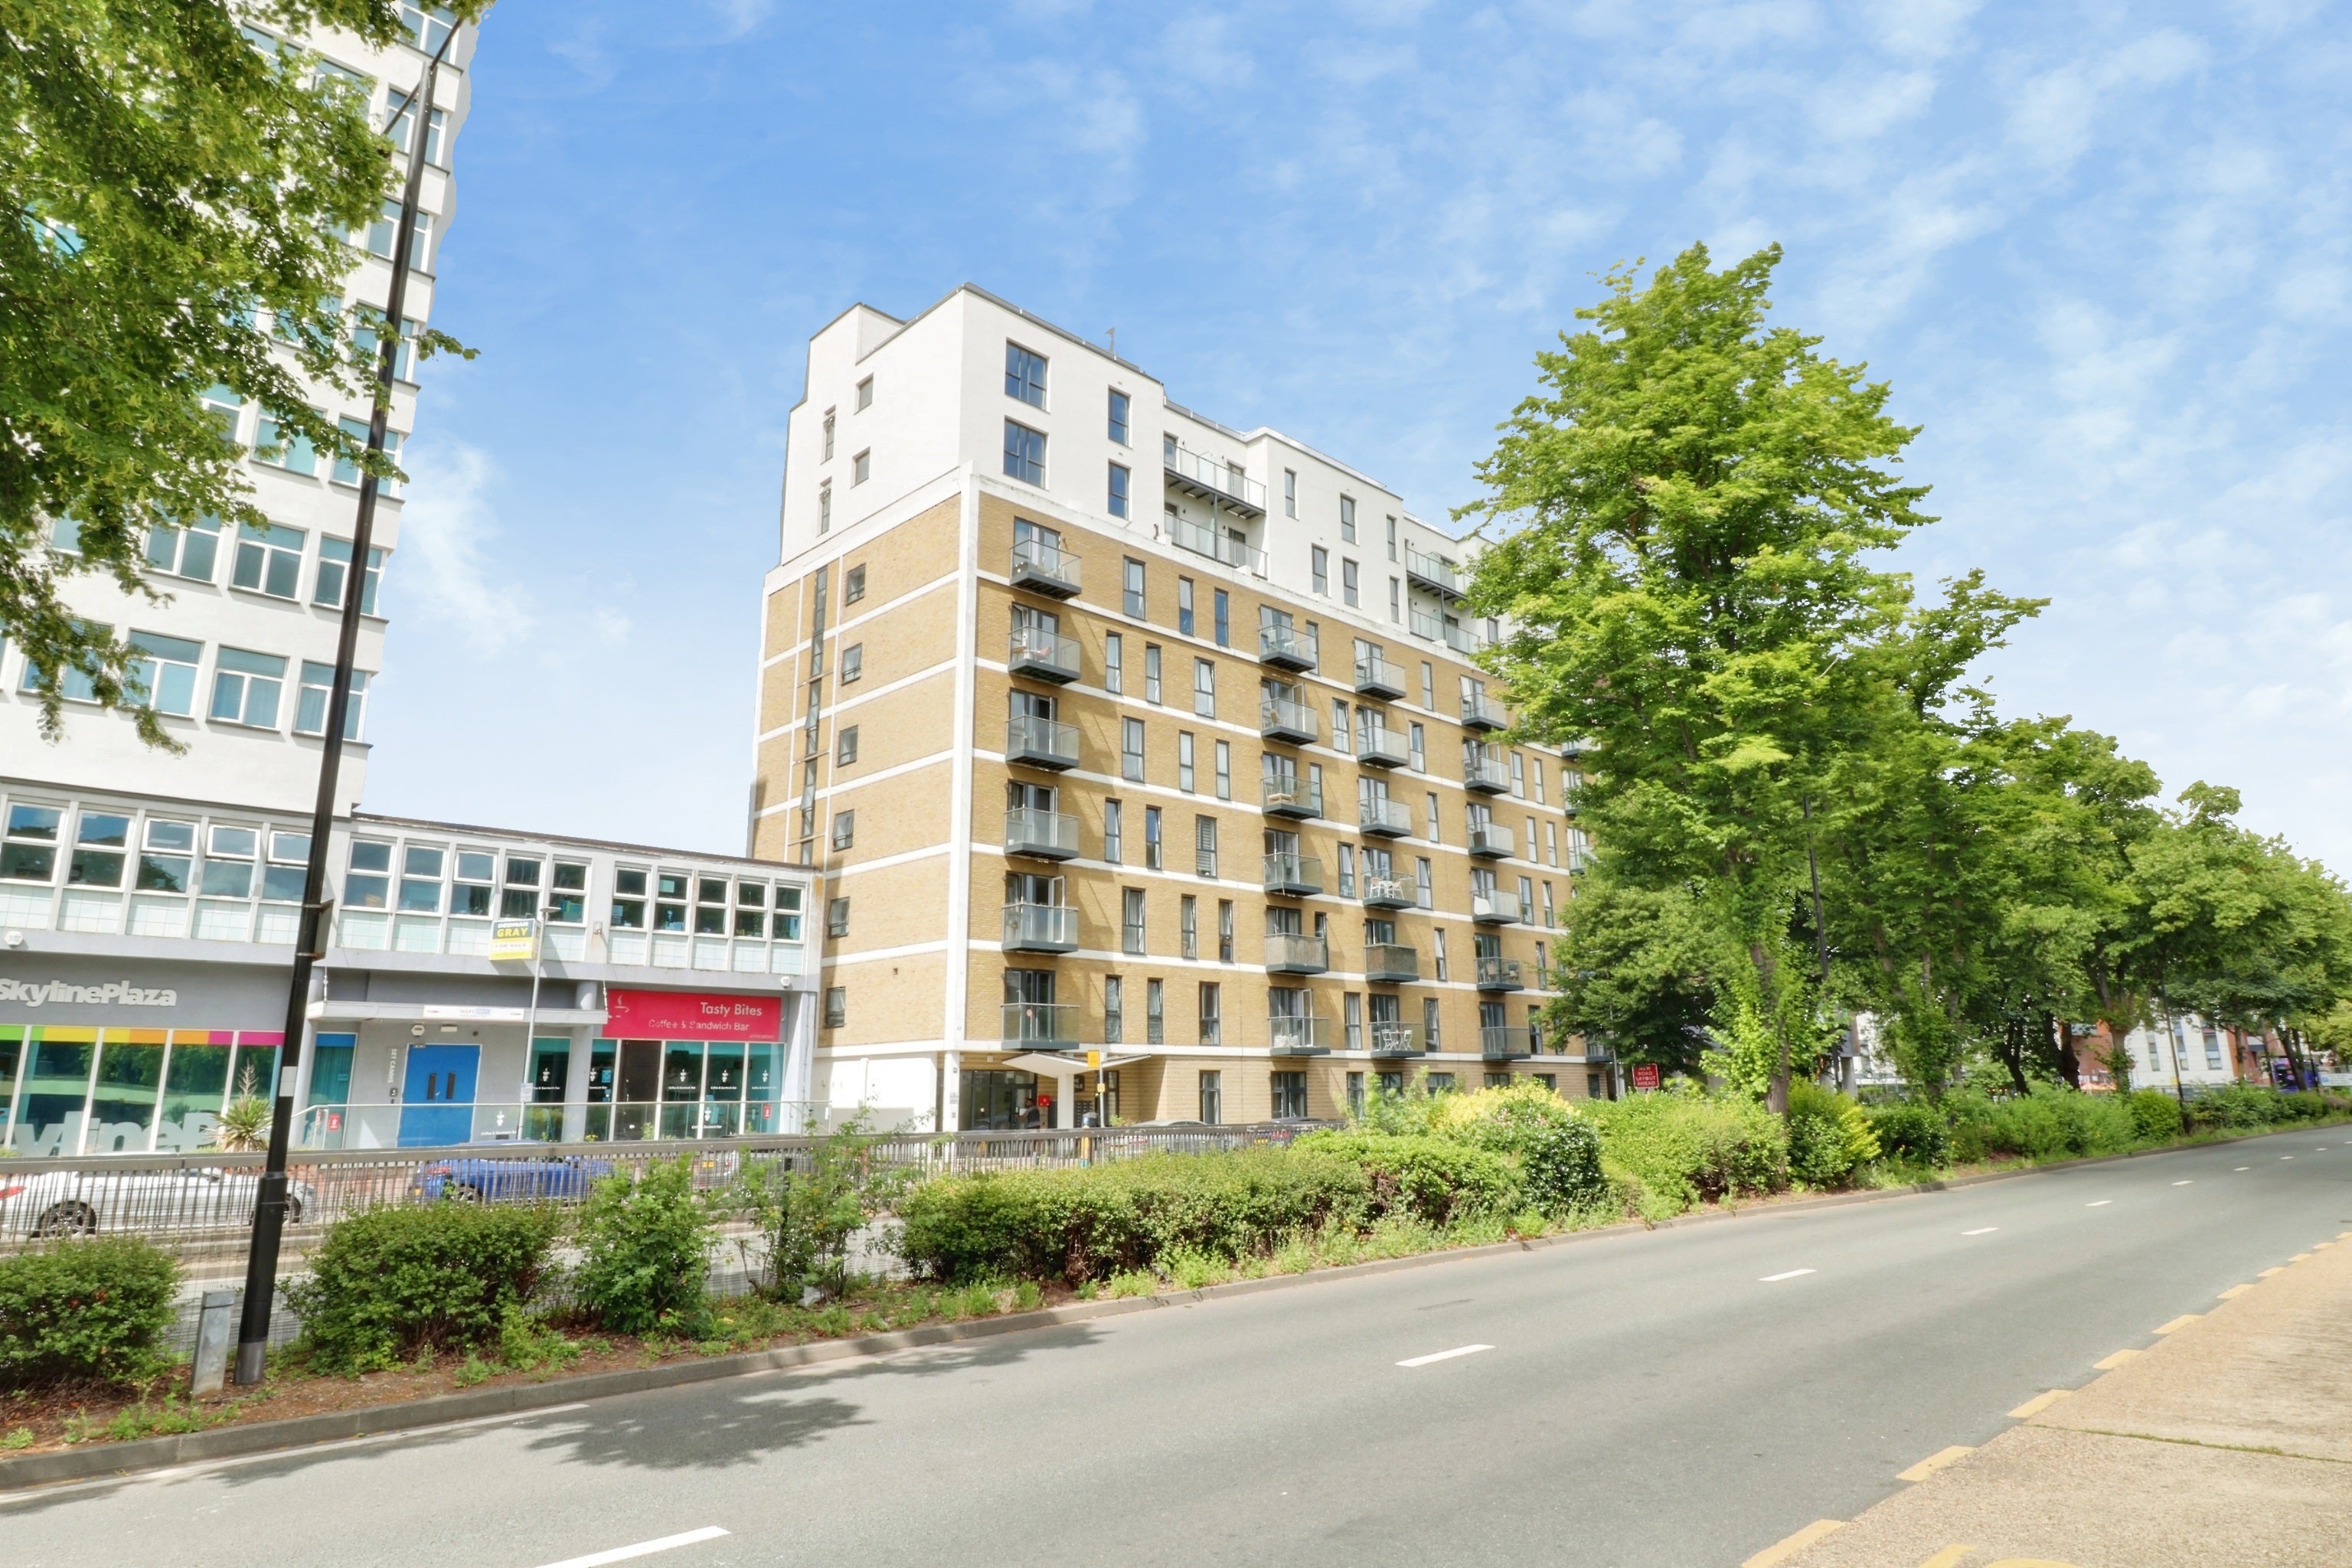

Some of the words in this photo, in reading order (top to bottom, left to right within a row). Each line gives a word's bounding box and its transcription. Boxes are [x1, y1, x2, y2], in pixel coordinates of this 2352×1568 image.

[497, 927, 528, 937] GRAY
[0, 978, 177, 1007] SkylinePlaza
[701, 1001, 730, 1017] Tasty
[734, 1004, 763, 1016] Bites
[648, 1019, 678, 1028] Coffee
[681, 1020, 687, 1028] &
[689, 1021, 731, 1030] Sandwich
[733, 1022, 750, 1031] Bar
